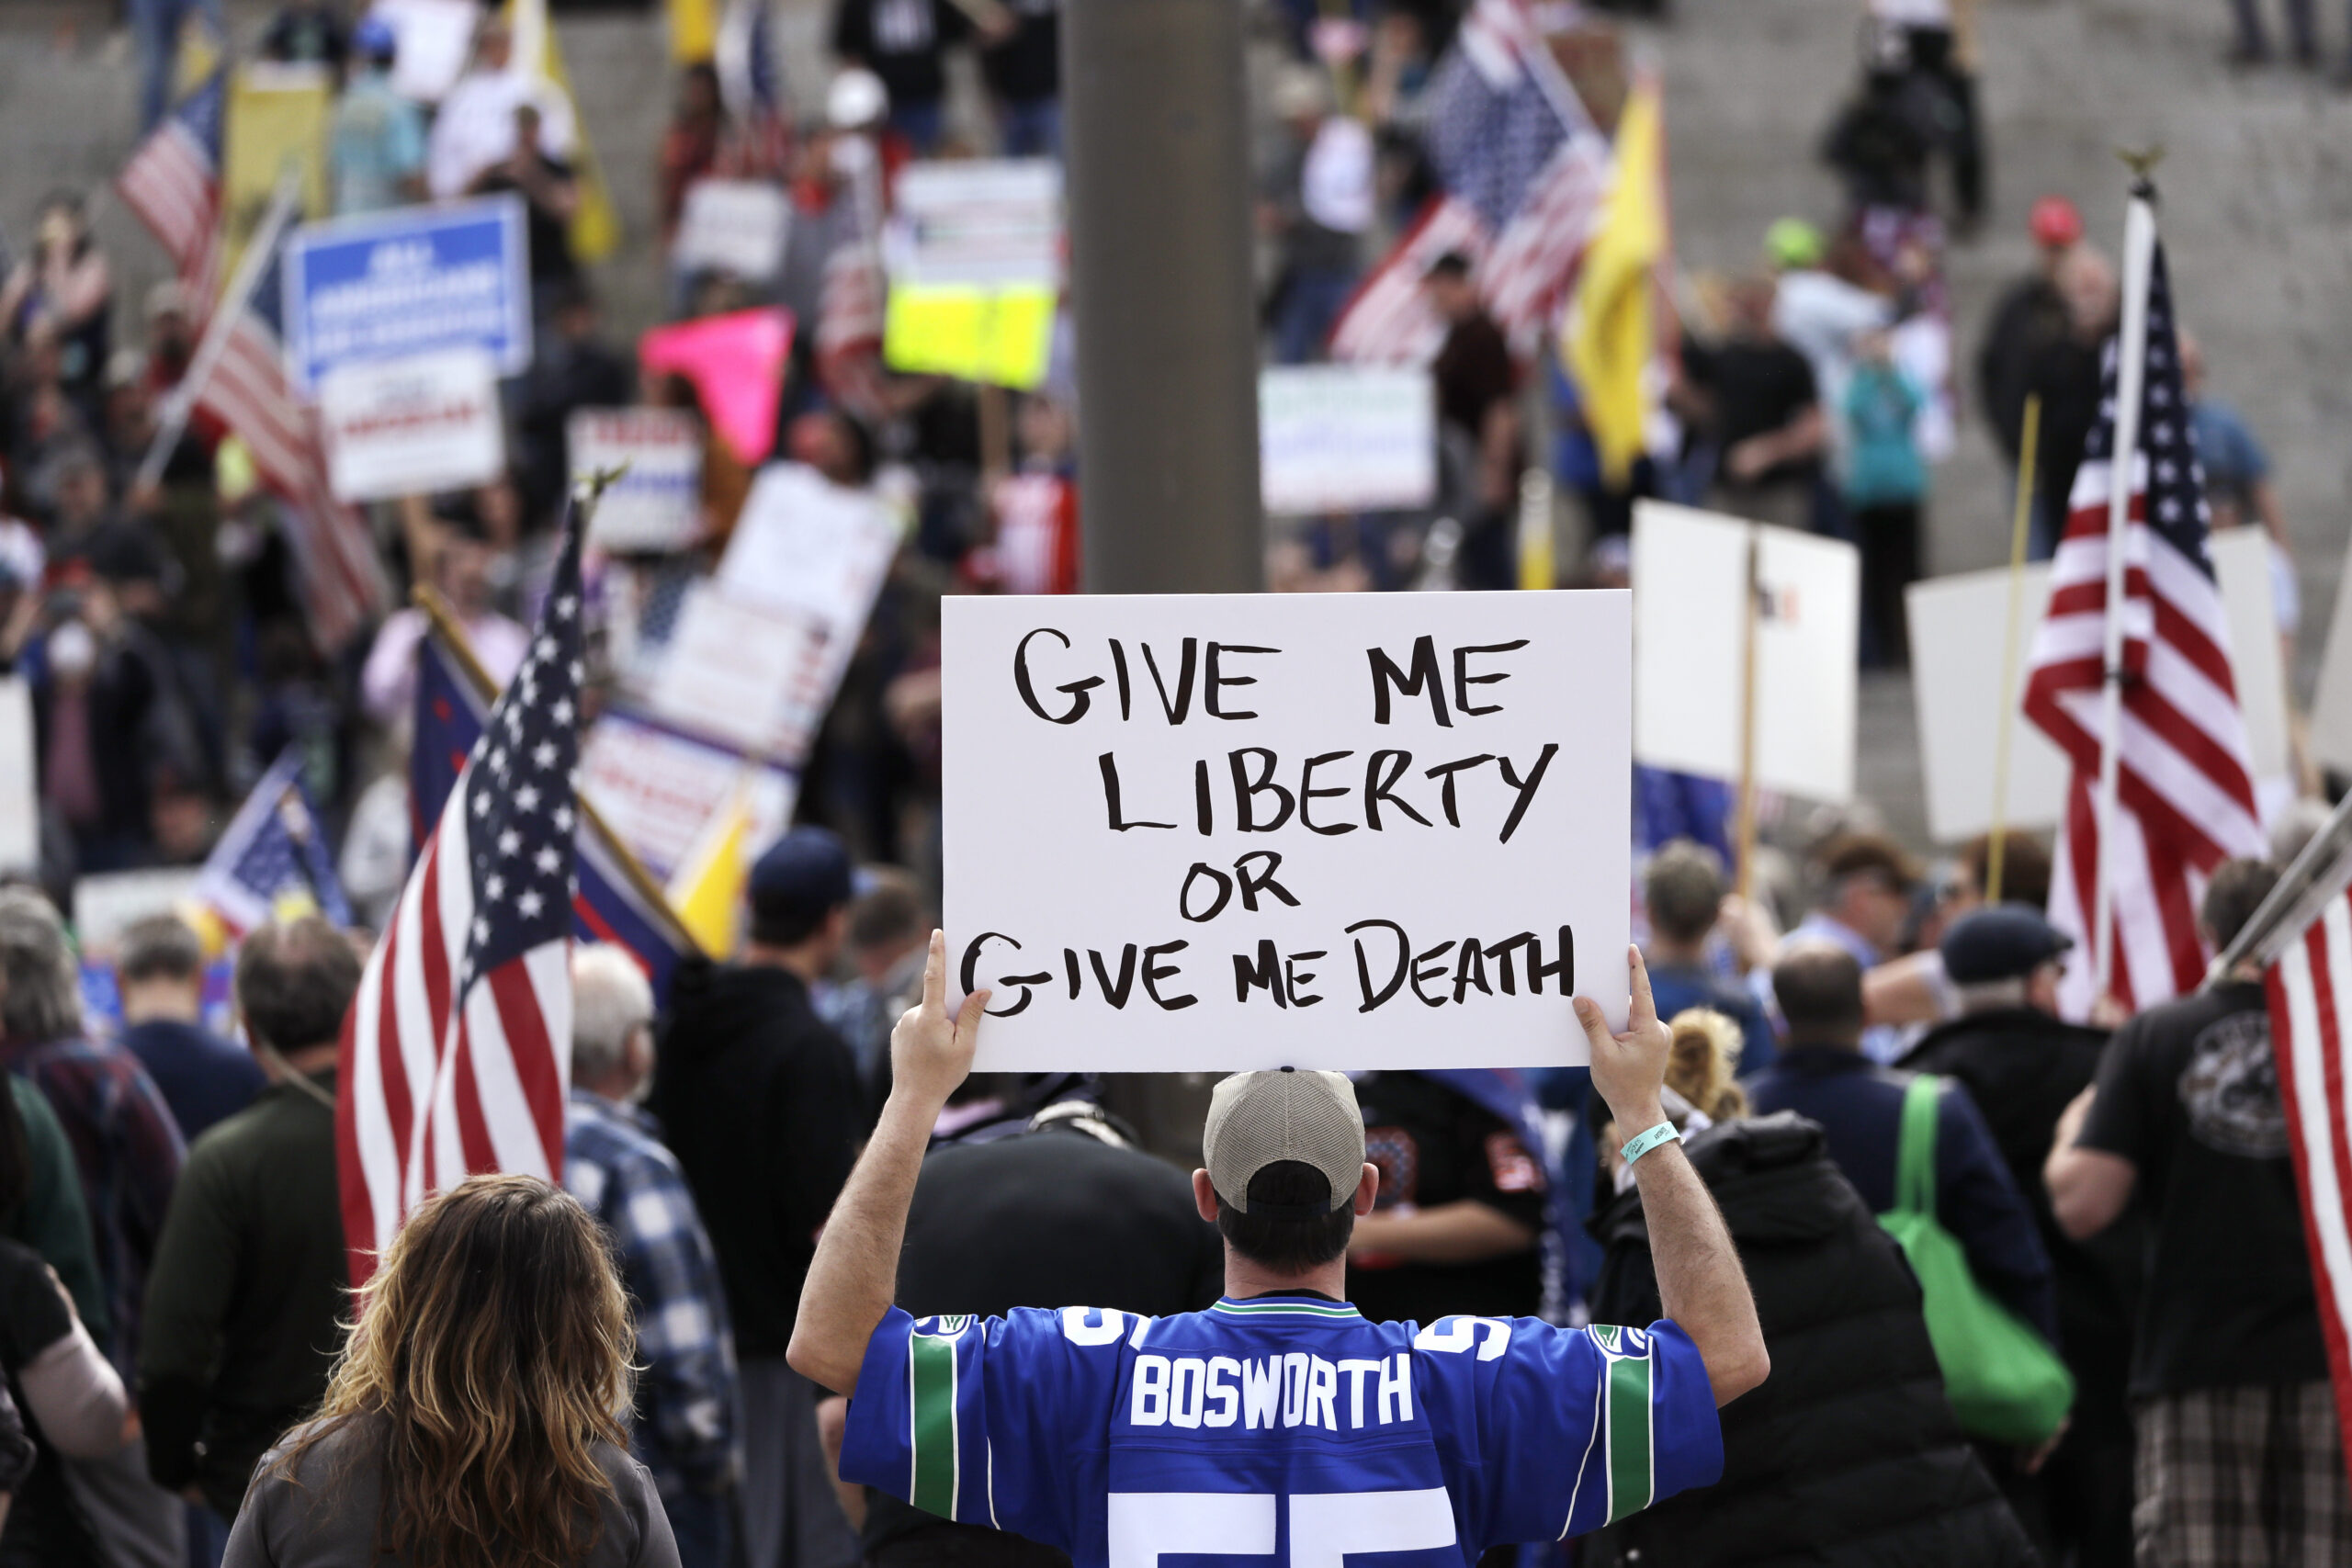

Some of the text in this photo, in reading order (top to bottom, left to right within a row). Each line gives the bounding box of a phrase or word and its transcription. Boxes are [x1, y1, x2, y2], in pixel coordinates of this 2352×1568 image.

[1013, 627, 1531, 728] GIVE ME
[1098, 743, 1559, 845] LIBERTY
[1180, 851, 1302, 923] OR
[959, 919, 1575, 1018] GIVE ME DEATH
[1130, 1352, 1414, 1432] BOSWORTH
